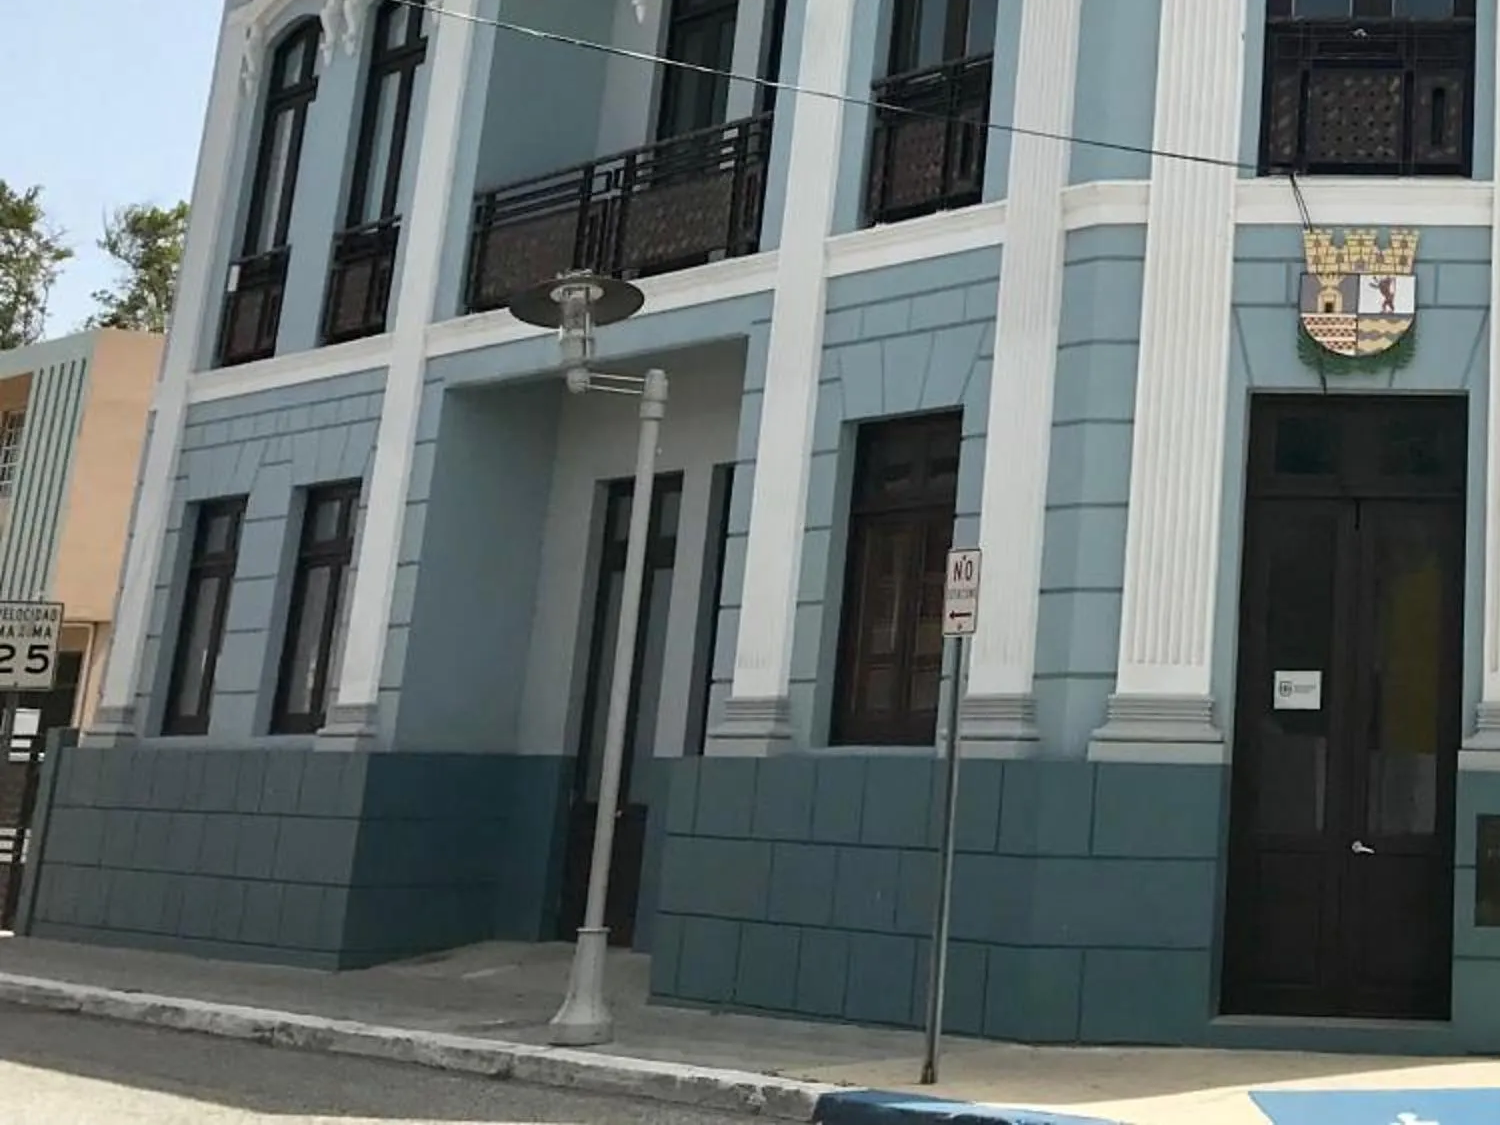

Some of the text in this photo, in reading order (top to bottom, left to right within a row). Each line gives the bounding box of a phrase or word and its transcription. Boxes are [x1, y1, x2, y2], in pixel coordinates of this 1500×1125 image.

[954, 560, 973, 582] NO
[0, 625, 52, 638] AXMA
[0, 644, 49, 674] 25
